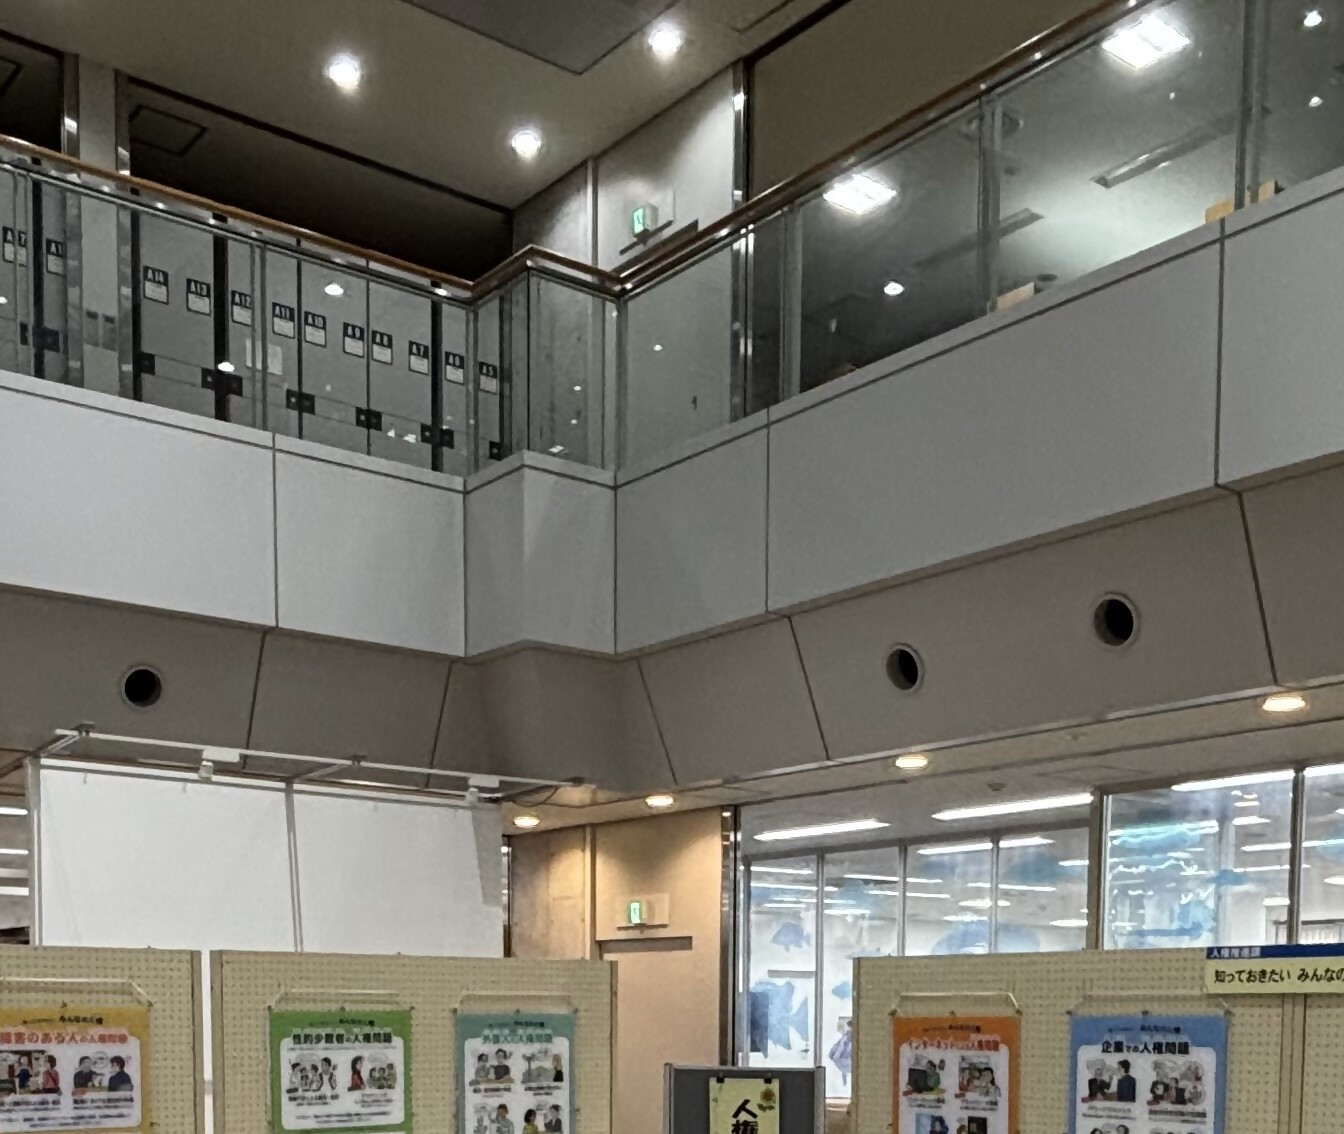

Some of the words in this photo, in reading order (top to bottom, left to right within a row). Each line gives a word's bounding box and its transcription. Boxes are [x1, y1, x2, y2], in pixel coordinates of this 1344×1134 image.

[7, 230, 25, 243] A7
[1214, 969, 1290, 983] 知っておきたい
[1101, 1040, 1190, 1055] 企業での人権問題
